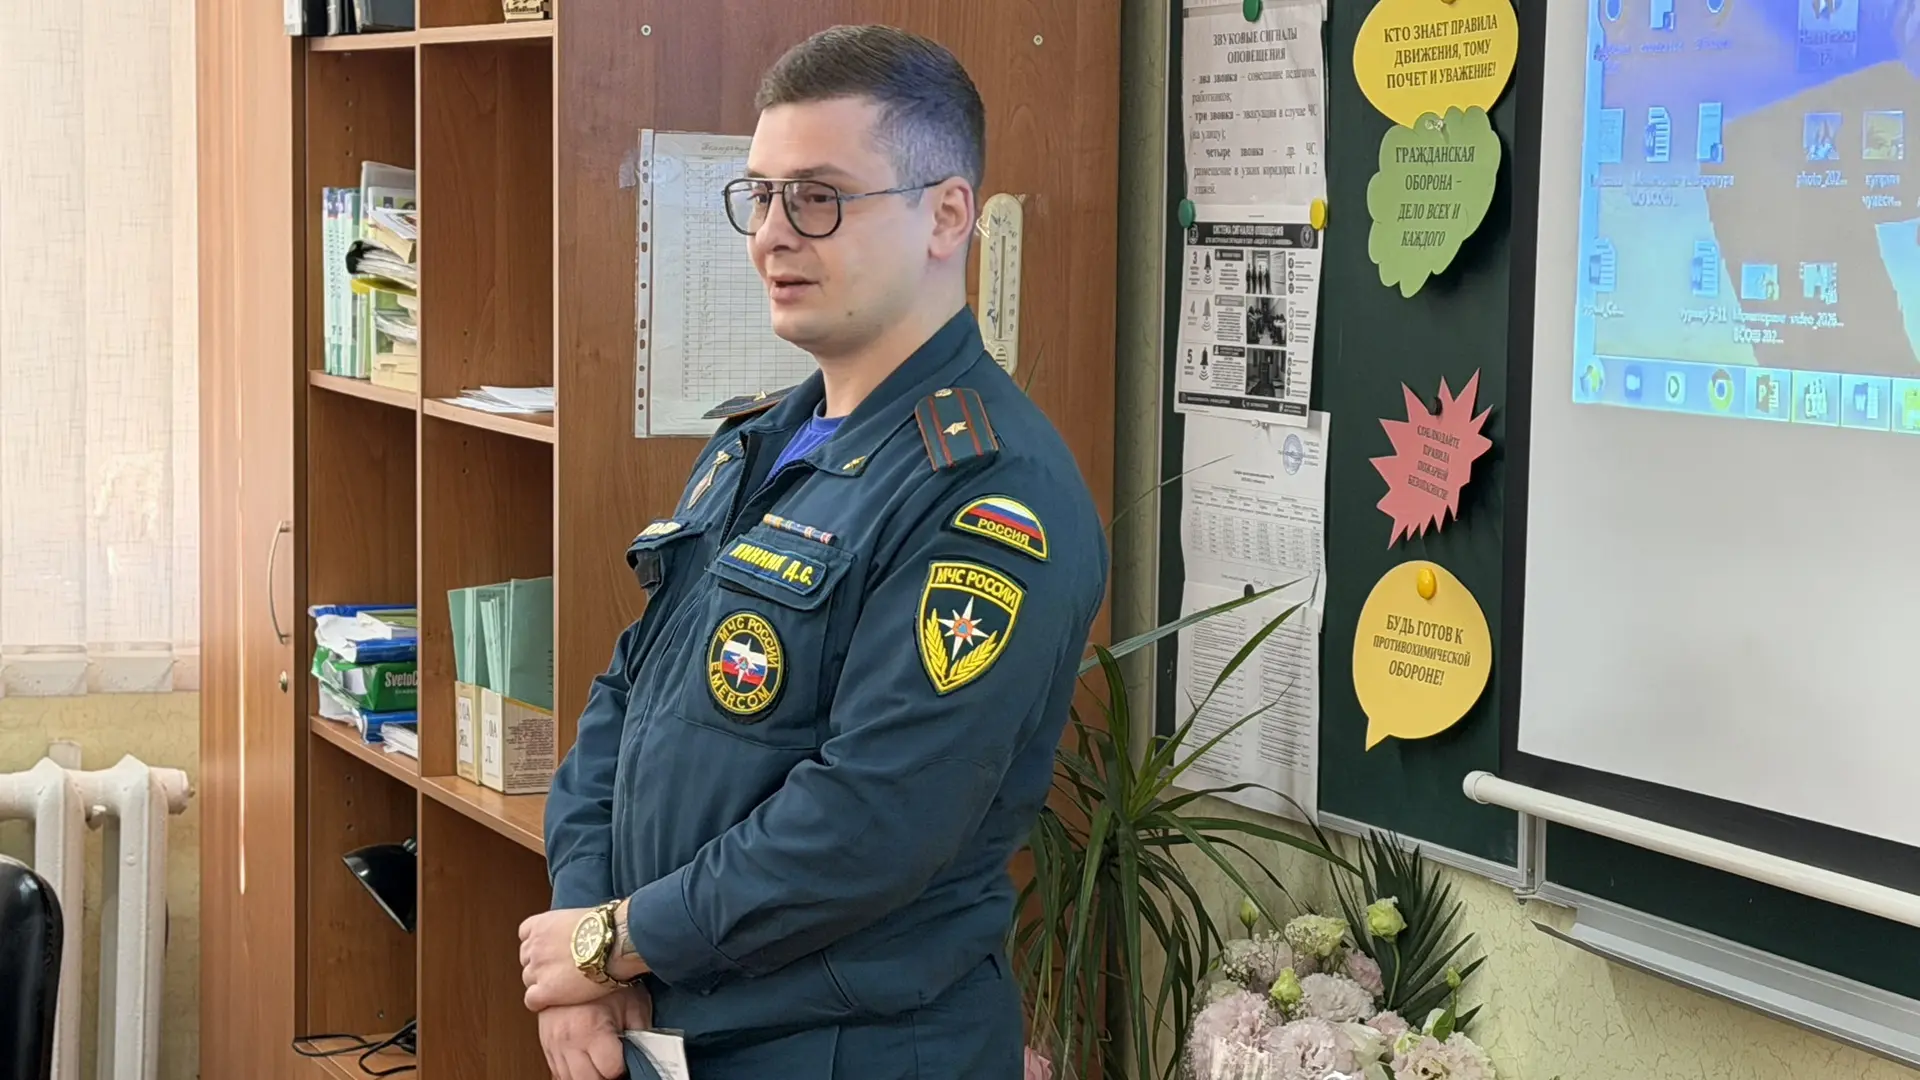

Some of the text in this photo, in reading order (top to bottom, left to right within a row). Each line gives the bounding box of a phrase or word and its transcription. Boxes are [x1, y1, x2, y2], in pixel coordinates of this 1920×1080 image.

[1213, 28, 1298, 46] ЗВУКОВЫЕ СИГНАЛЫ
[1384, 14, 1498, 43] КТО ЗНАЕТ ПРАВИЛА
[1227, 48, 1286, 64] ОПОВЕЩЕНИЯ
[1394, 39, 1492, 68] ДВИЖЕНИЯ, ТОМУ
[1387, 62, 1497, 89] ПОЧЕТ И УВАЖЕНИЕ!
[1396, 146, 1475, 166] ГРАЖДАНСКАЯ
[1405, 174, 1452, 191] ОБОРОНА
[1397, 203, 1461, 222] ДЕЛО ВСЕХ И
[1401, 230, 1446, 250] КАЖДОГО
[1186, 348, 1193, 364] 5
[977, 517, 1031, 546] РОССИЯ
[782, 560, 813, 586] Д.С.
[936, 567, 1017, 608] МЧС РОССИИ
[718, 616, 779, 668] МЧС РОССИИ
[1386, 614, 1464, 645] БУДЬ ГОТОВ К
[1373, 635, 1471, 668] ПРОТИВОХИМИЧЕСКОЙ
[710, 661, 772, 709] EMERCOM
[1388, 660, 1445, 686] ОБОРОНЕ!
